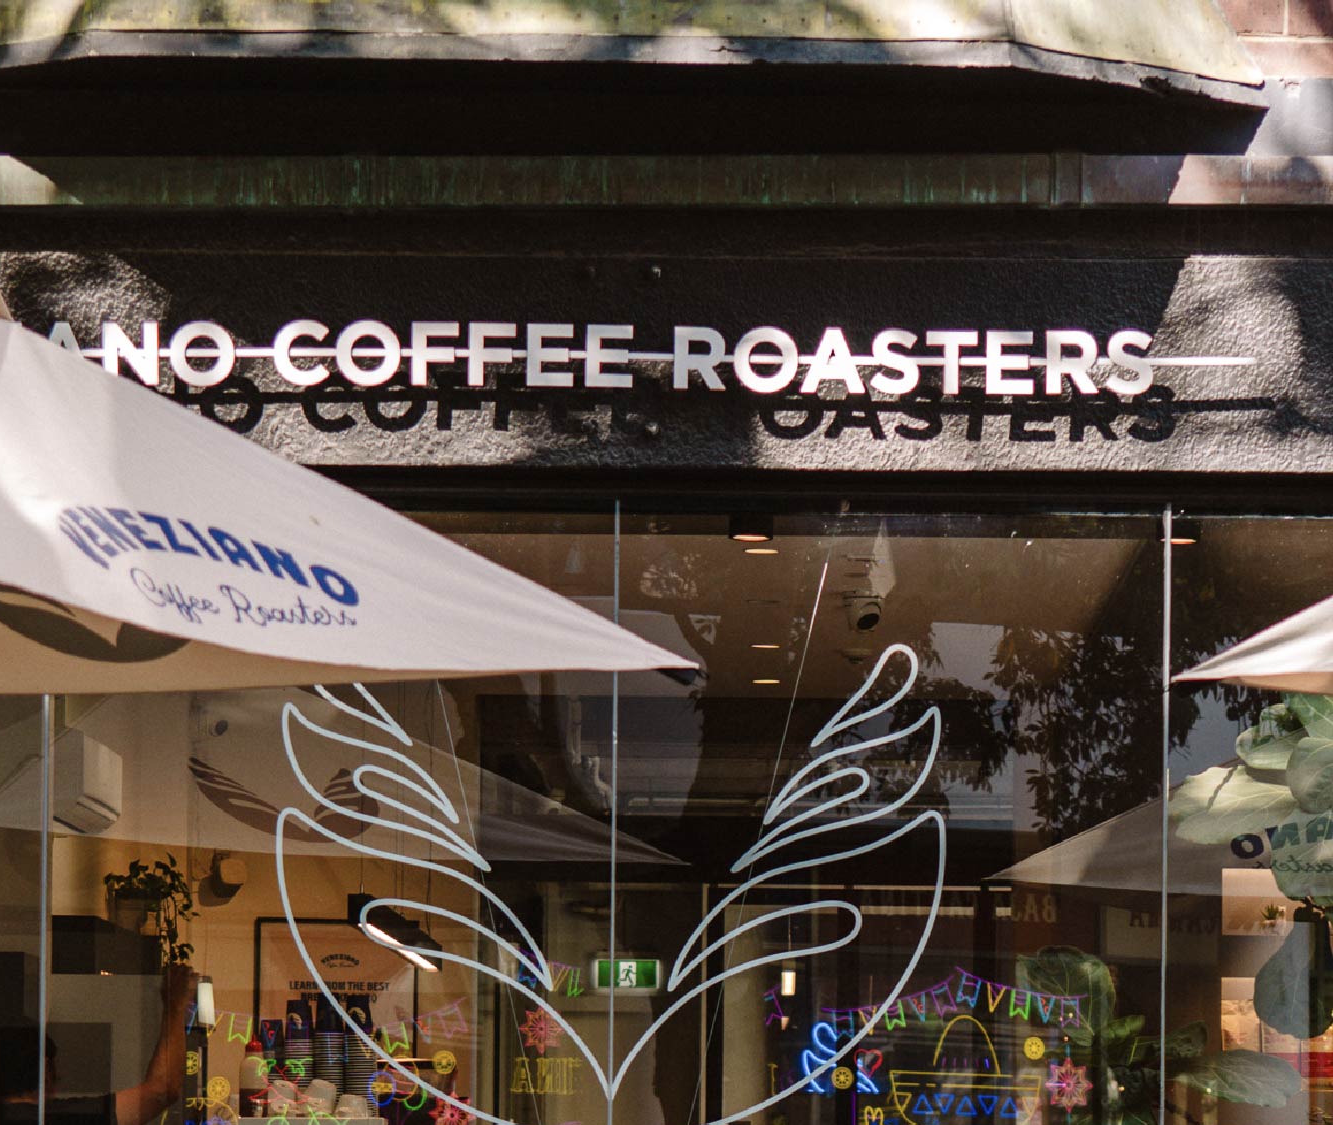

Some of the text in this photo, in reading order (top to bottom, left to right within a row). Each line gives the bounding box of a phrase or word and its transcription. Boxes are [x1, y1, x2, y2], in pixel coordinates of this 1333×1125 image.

[273, 320, 633, 388] COFFEE
[673, 326, 1154, 396] ROASTERS
[59, 506, 360, 607] VENEZIANO
[130, 567, 358, 627] Coffee Roasters
